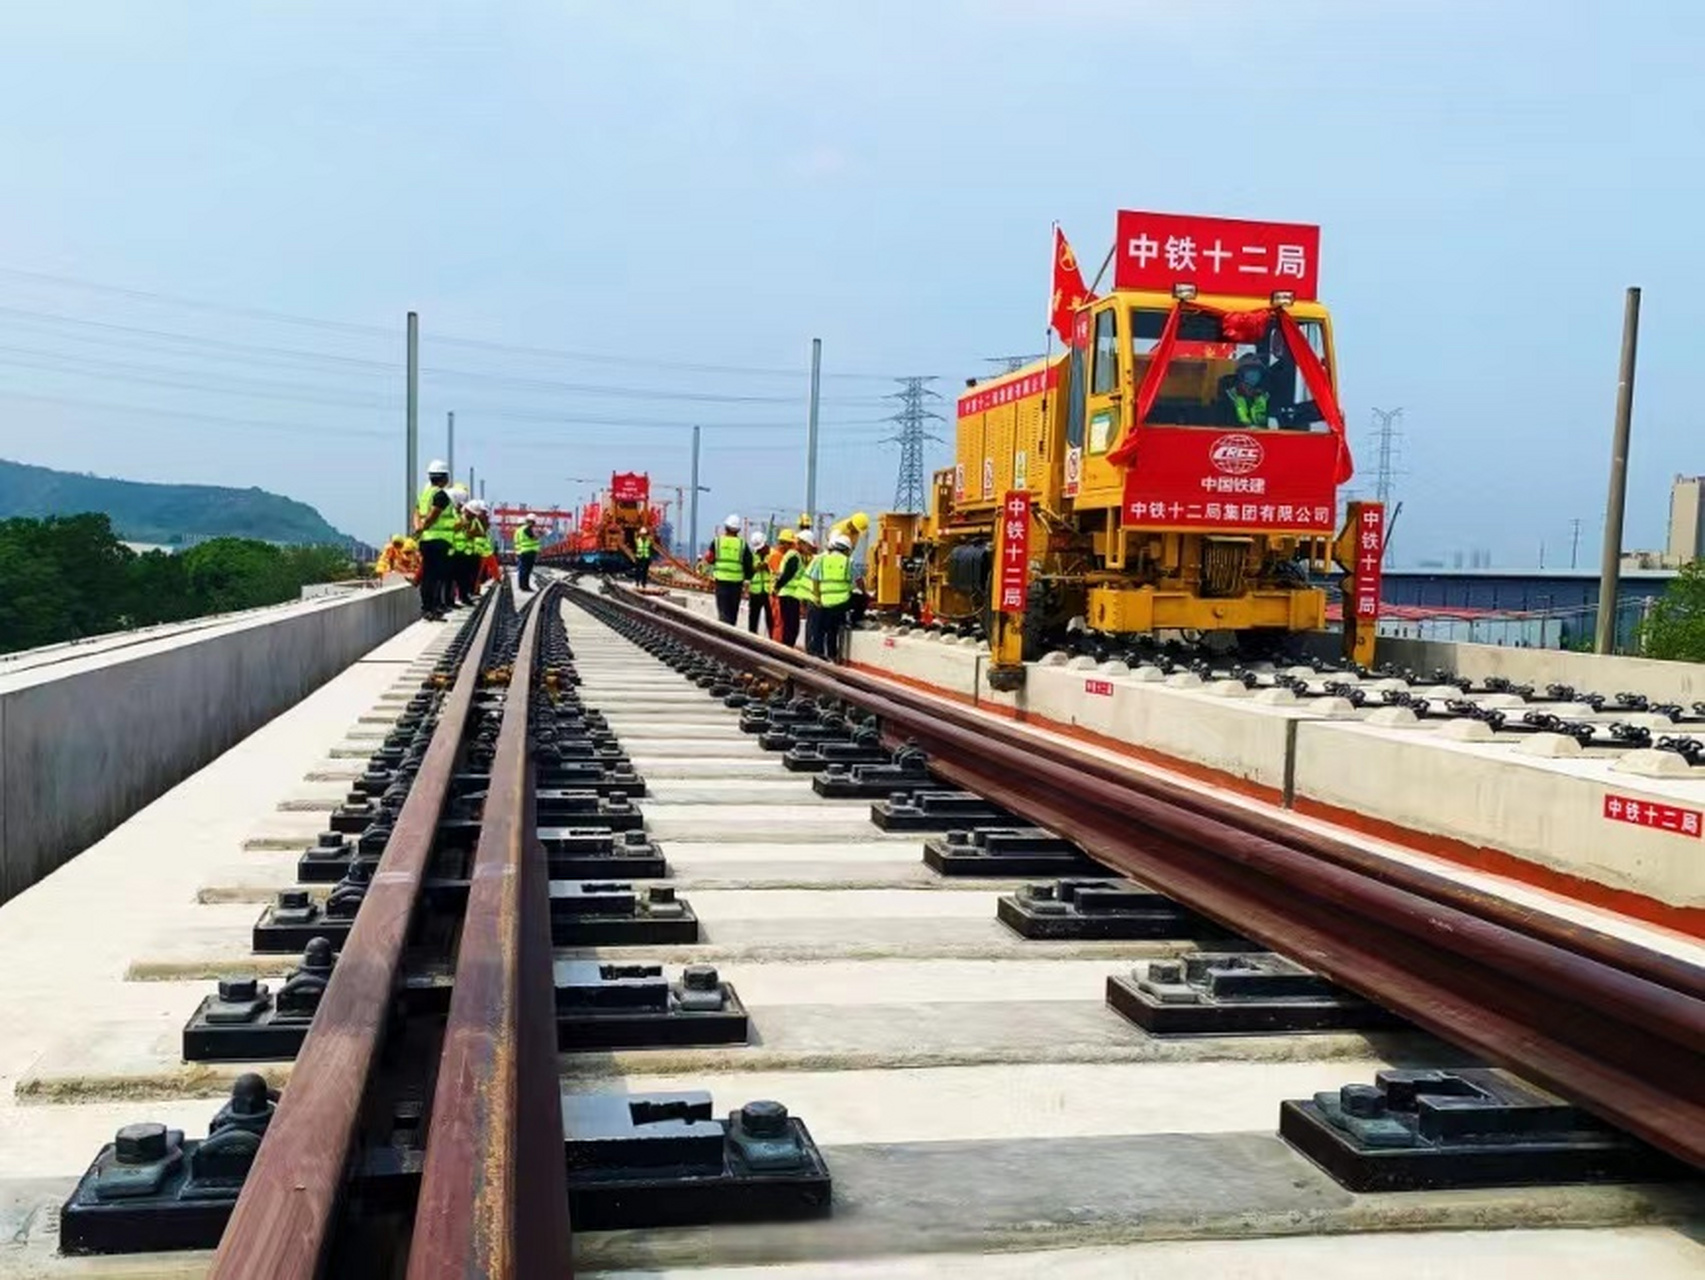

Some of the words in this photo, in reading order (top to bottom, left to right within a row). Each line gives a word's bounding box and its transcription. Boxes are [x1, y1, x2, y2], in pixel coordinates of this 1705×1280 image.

[1127, 232, 1306, 279] 中铁十二局
[1201, 475, 1265, 494] 中国铁建
[1130, 501, 1330, 524] 中铁十二局集团有限公司
[1003, 497, 1026, 607] 中铁十二局
[1358, 510, 1380, 615] 中铁十二局
[1608, 798, 1698, 835] 中铁十二局
